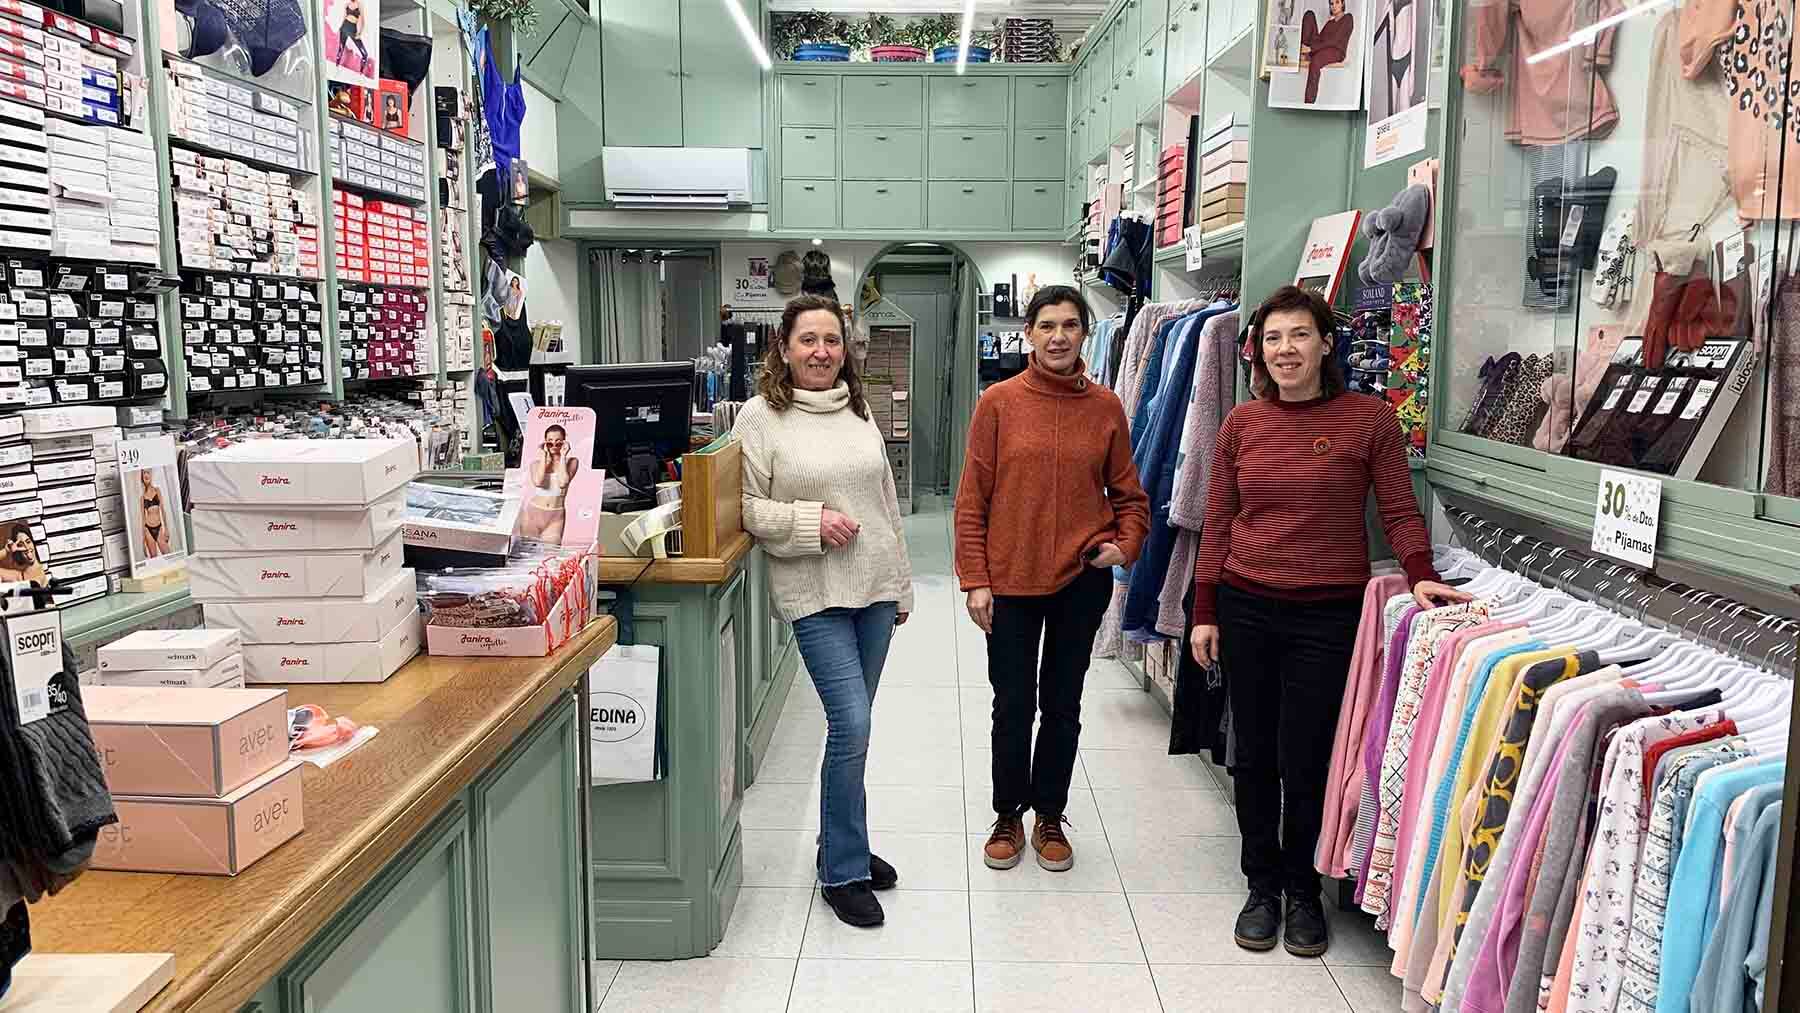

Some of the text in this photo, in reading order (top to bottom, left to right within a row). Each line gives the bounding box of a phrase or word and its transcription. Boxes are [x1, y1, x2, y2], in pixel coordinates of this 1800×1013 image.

[735, 279, 749, 290] 30
[538, 409, 570, 419] Janira
[121, 447, 140, 465] 249
[260, 475, 291, 485] Janira
[1602, 480, 1626, 519] 30
[1639, 511, 1654, 527] Dto.
[267, 521, 297, 532] Janira
[1615, 530, 1653, 554] Pijamas
[261, 569, 291, 580] Janira
[277, 616, 305, 627] Janira
[461, 633, 493, 644] Janira
[280, 656, 310, 667] Janira
[591, 708, 636, 724] EDINA
[239, 723, 275, 756] avet
[253, 798, 289, 833] avet
